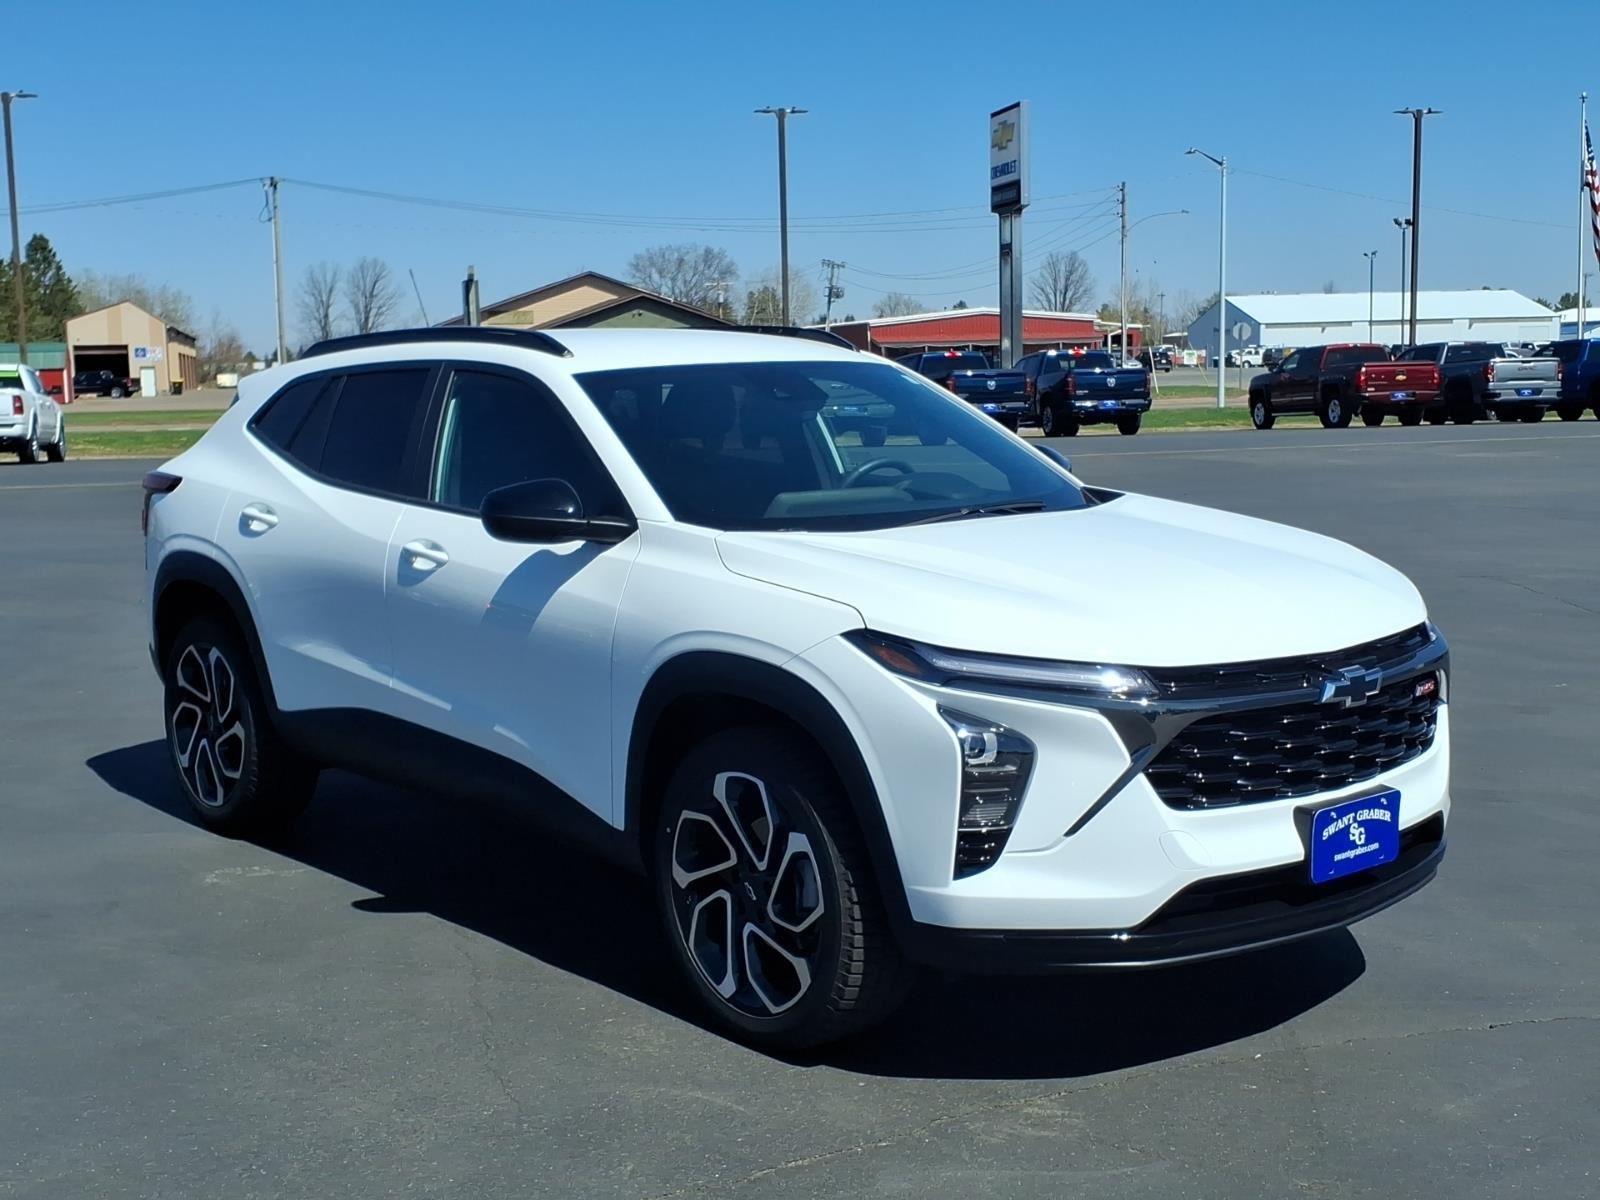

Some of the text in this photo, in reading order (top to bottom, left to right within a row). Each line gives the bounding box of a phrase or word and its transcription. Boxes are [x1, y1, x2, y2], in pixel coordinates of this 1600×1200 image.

[1322, 808, 1391, 840] SWANT GRABER
[1349, 822, 1366, 845] SG
[1333, 842, 1379, 861] swantgraber.com
